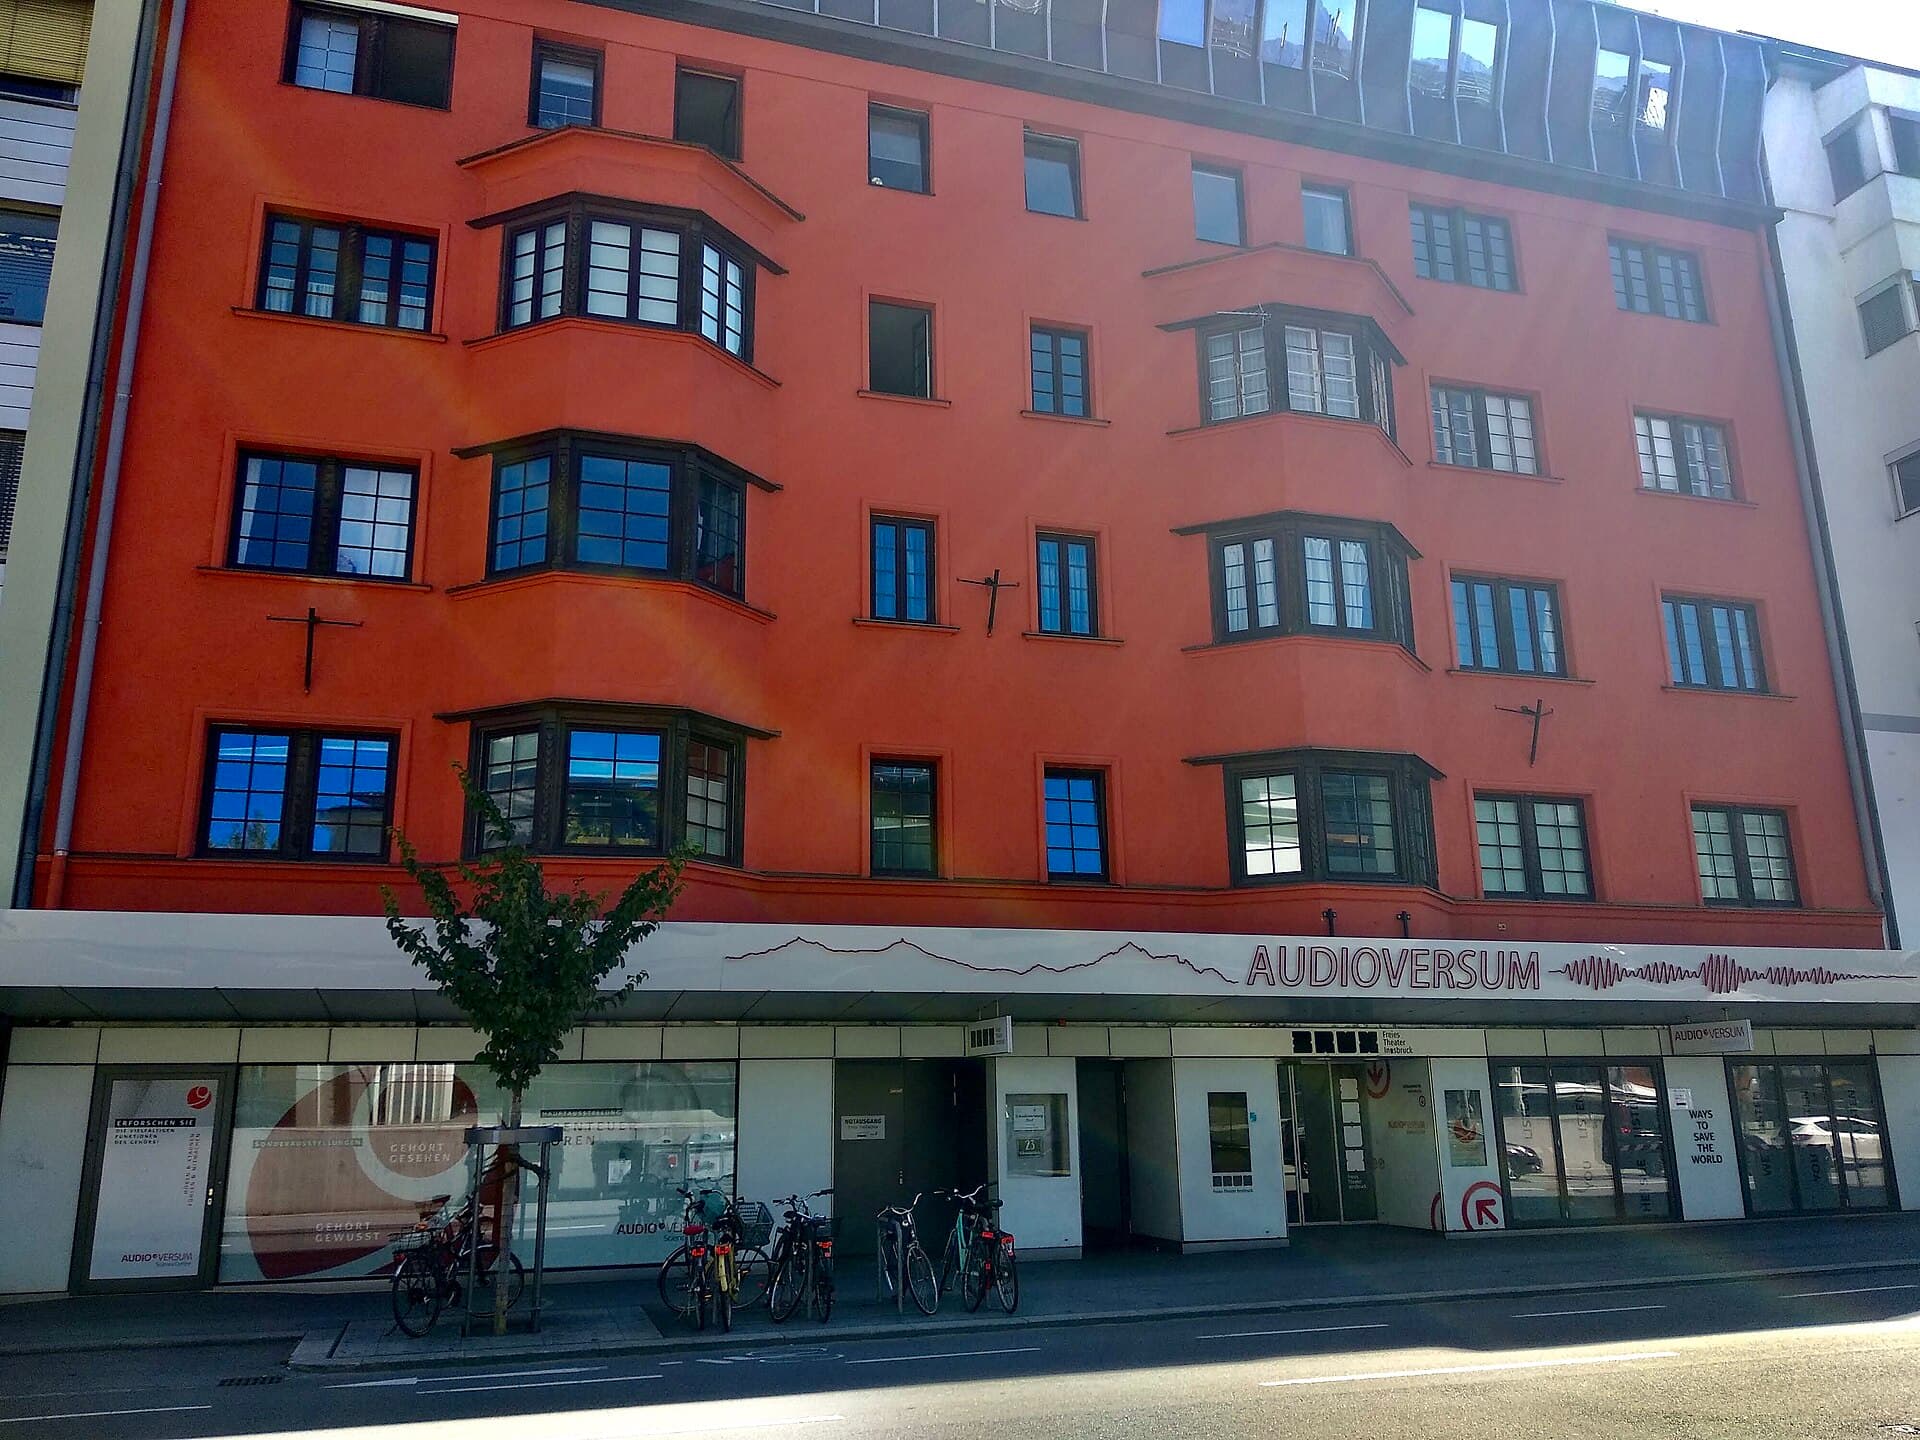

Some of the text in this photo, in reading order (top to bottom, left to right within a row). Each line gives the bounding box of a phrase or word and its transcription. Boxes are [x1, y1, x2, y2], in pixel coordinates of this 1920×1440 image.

[1247, 945, 1540, 990] AUDIOVERSUM
[1382, 1031, 1401, 1039] Freies
[1383, 1039, 1406, 1047] Theater
[1689, 1109, 1714, 1119] WAYS
[116, 1119, 176, 1127] ERFORSCHEN
[1696, 1121, 1709, 1130] TO
[1693, 1132, 1716, 1142] SAVE
[1025, 1139, 1035, 1151] 23
[1696, 1143, 1715, 1153] THE
[1691, 1154, 1723, 1165] WORLD
[617, 1222, 658, 1235] AUDIO
[121, 1253, 152, 1262] AUDIO
